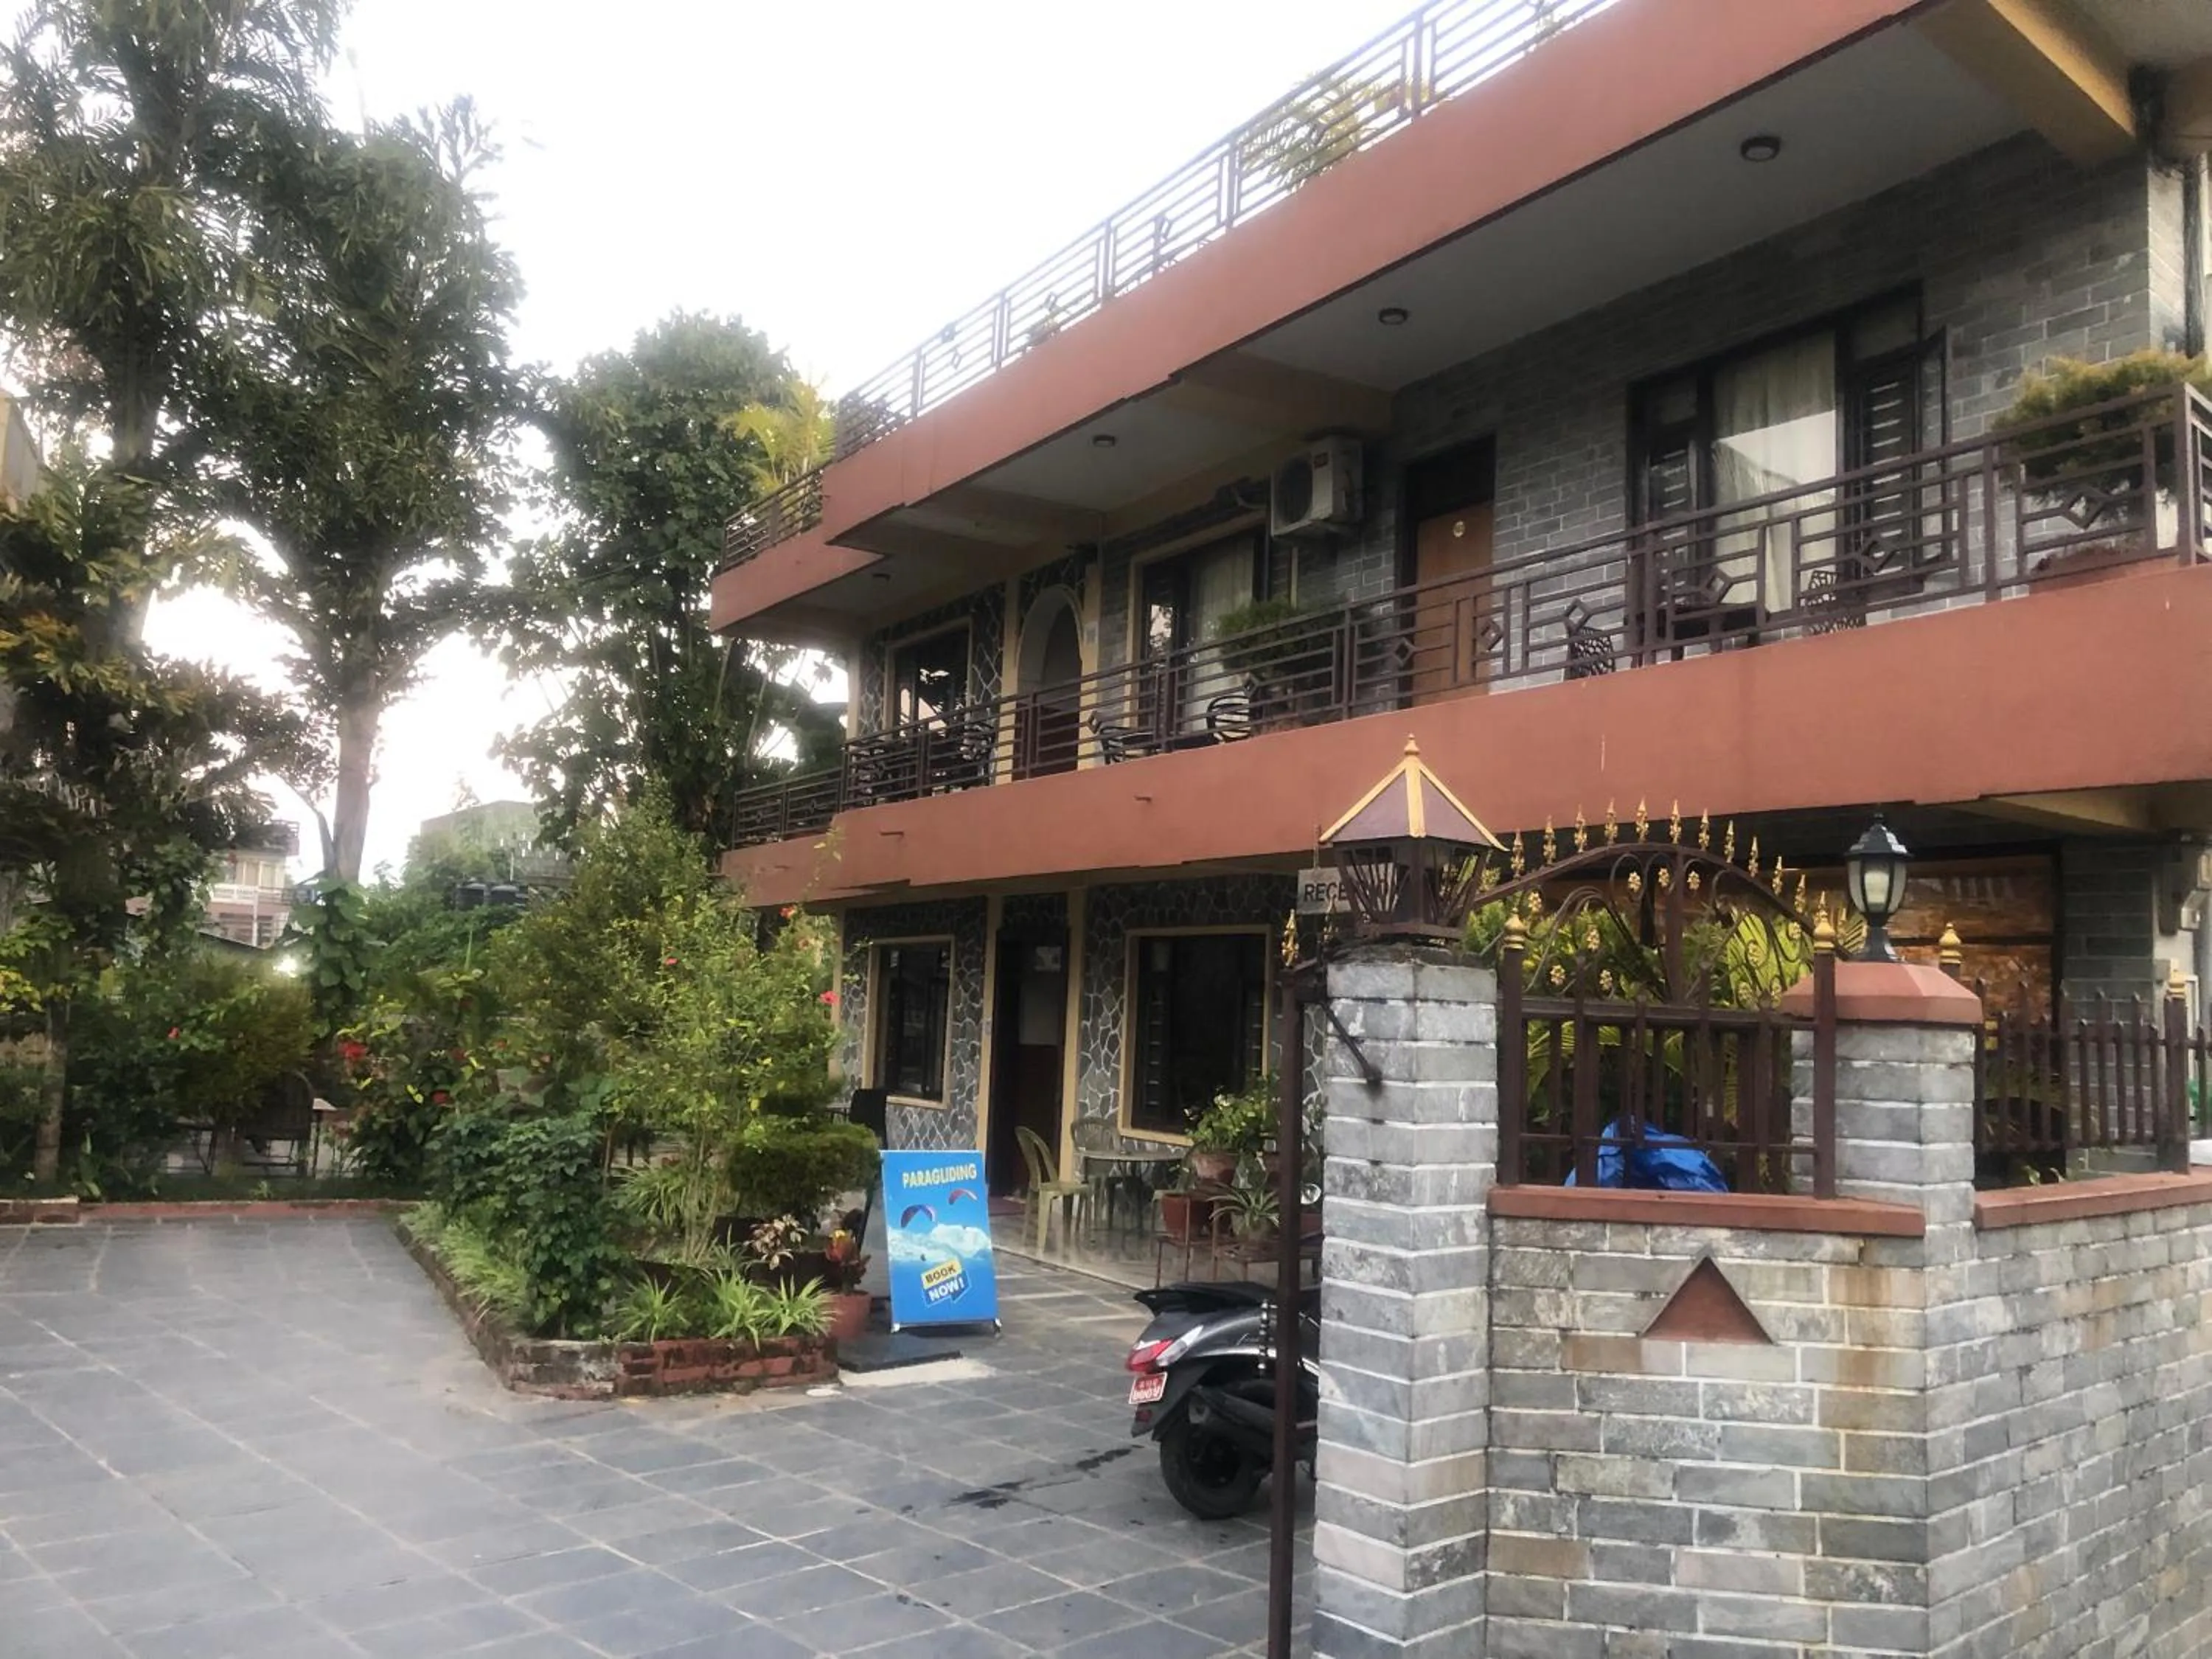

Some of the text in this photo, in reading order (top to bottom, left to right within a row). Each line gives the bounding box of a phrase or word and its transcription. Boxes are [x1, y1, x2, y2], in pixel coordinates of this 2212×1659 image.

[902, 1163, 977, 1189] PARAGLIDING
[925, 1264, 956, 1284] BOOK
[928, 1276, 964, 1301] NOW!
